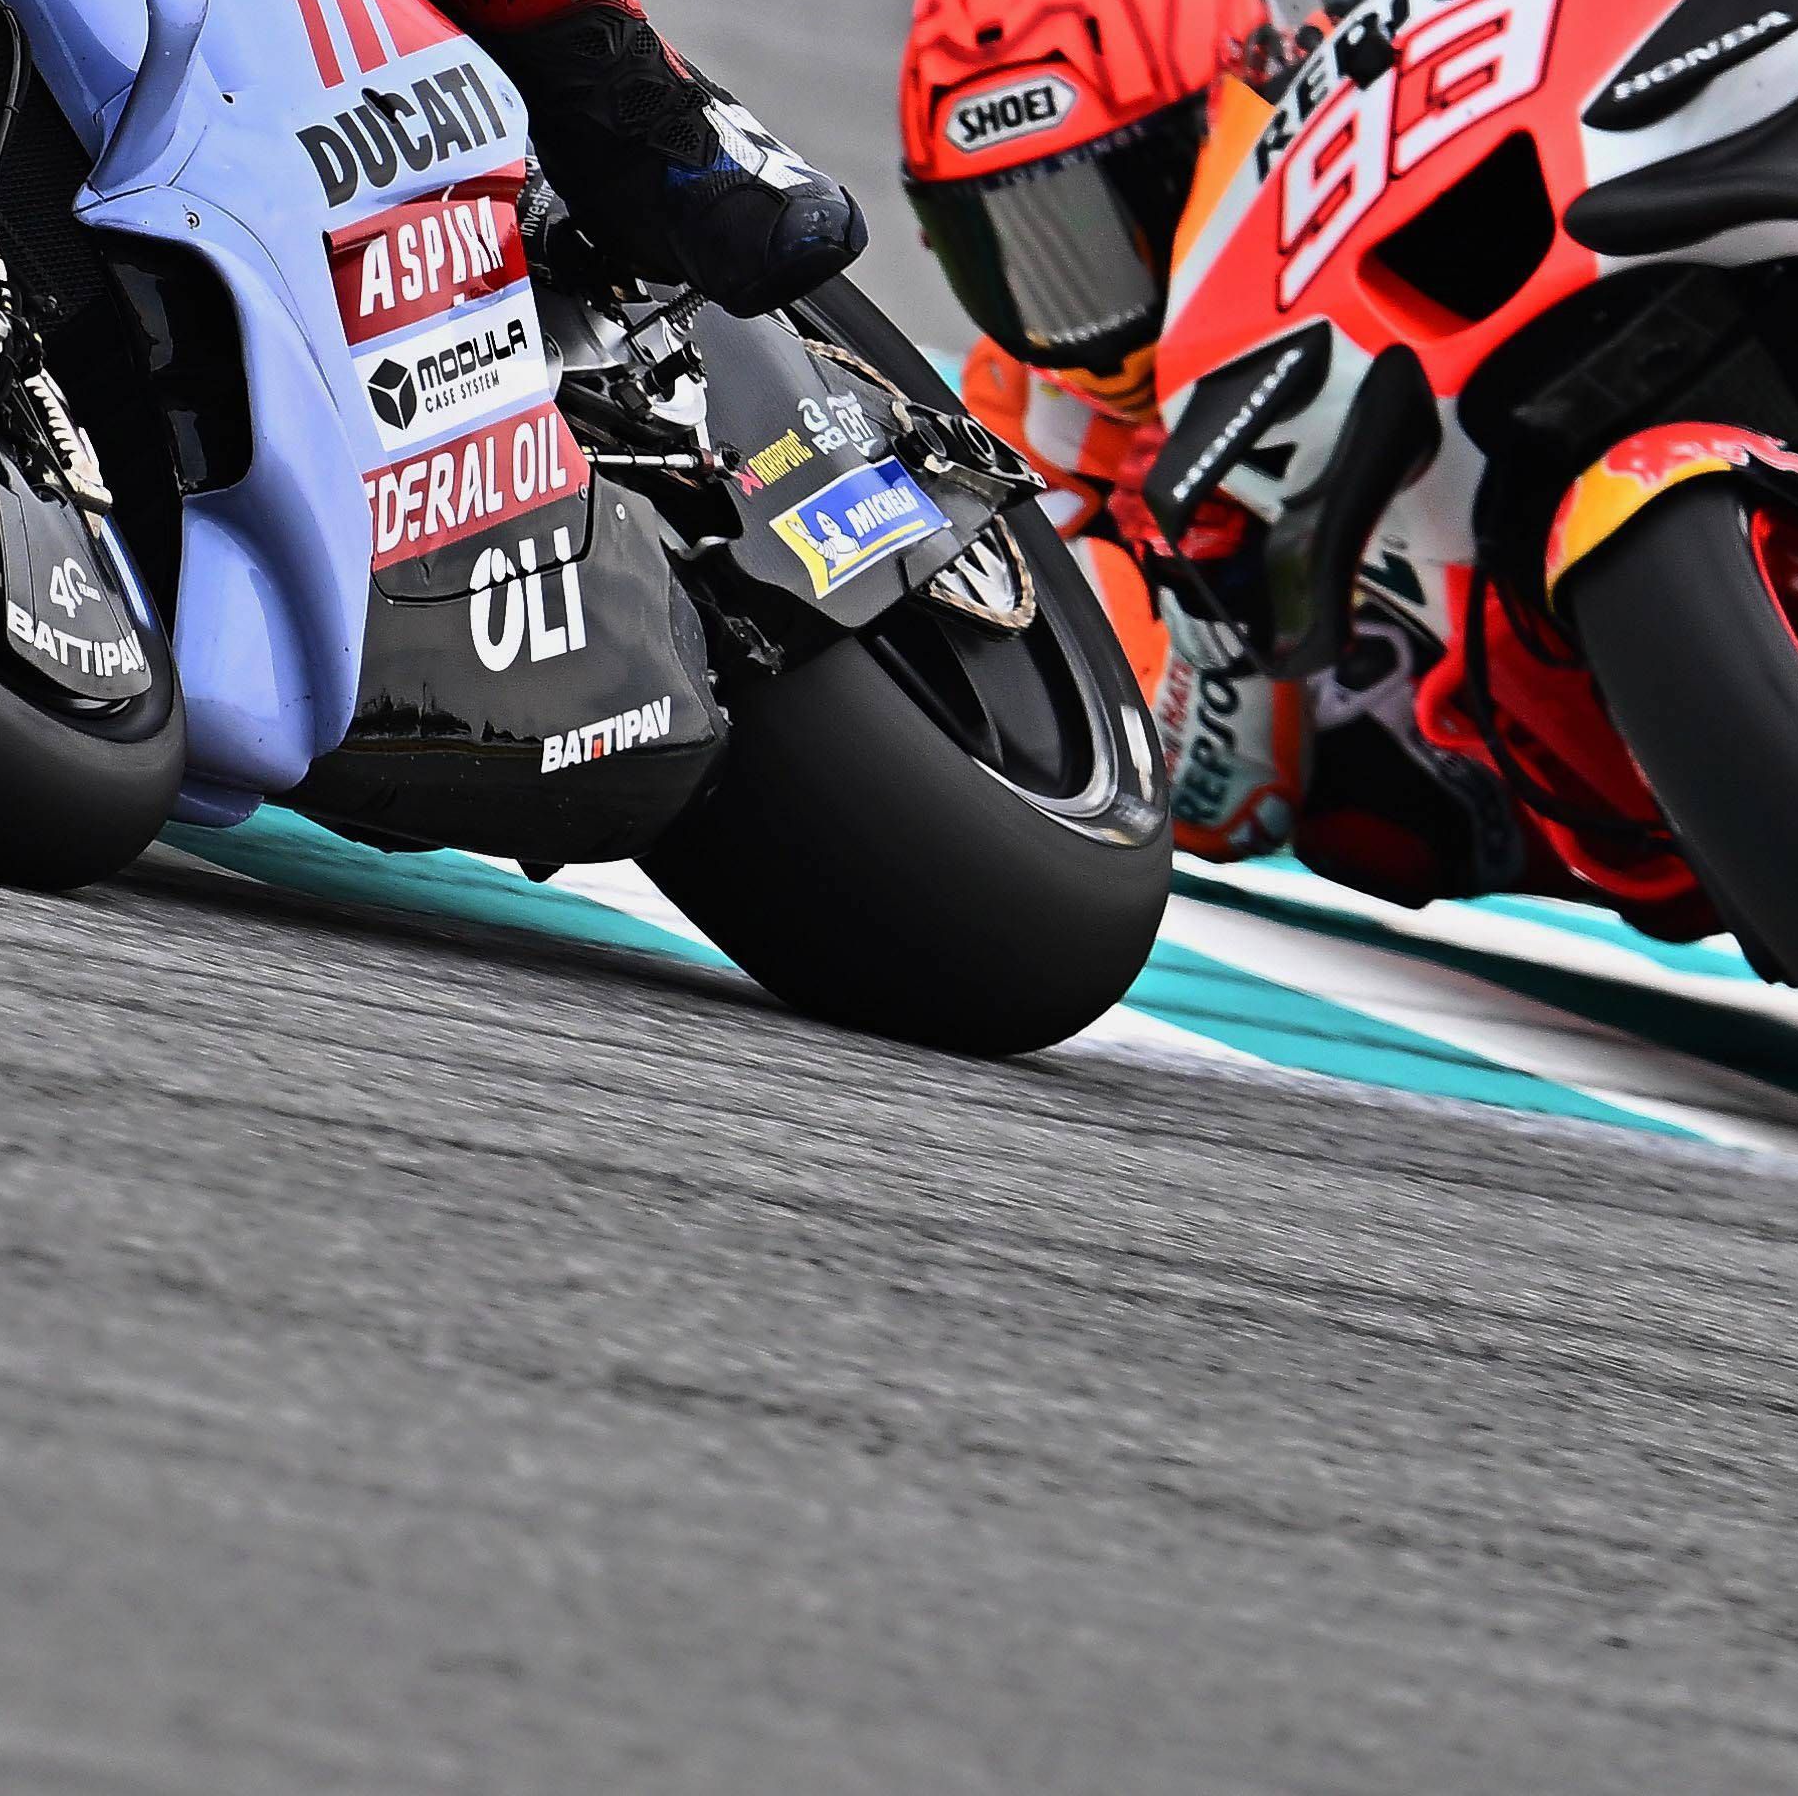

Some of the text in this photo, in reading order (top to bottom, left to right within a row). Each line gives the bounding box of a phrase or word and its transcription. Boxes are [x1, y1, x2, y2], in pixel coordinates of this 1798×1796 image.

[1614, 9, 1791, 101] HONDA
[296, 62, 507, 209] DUCATI
[958, 86, 1058, 142] SHOEI
[359, 192, 504, 317] ASPIRA
[417, 318, 528, 391] MODULA
[425, 375, 501, 414] CASE SYSTEM
[364, 412, 567, 554] DERAL OIL
[7, 599, 146, 677] BATTIPAV
[541, 696, 672, 775] BATTIPAV
